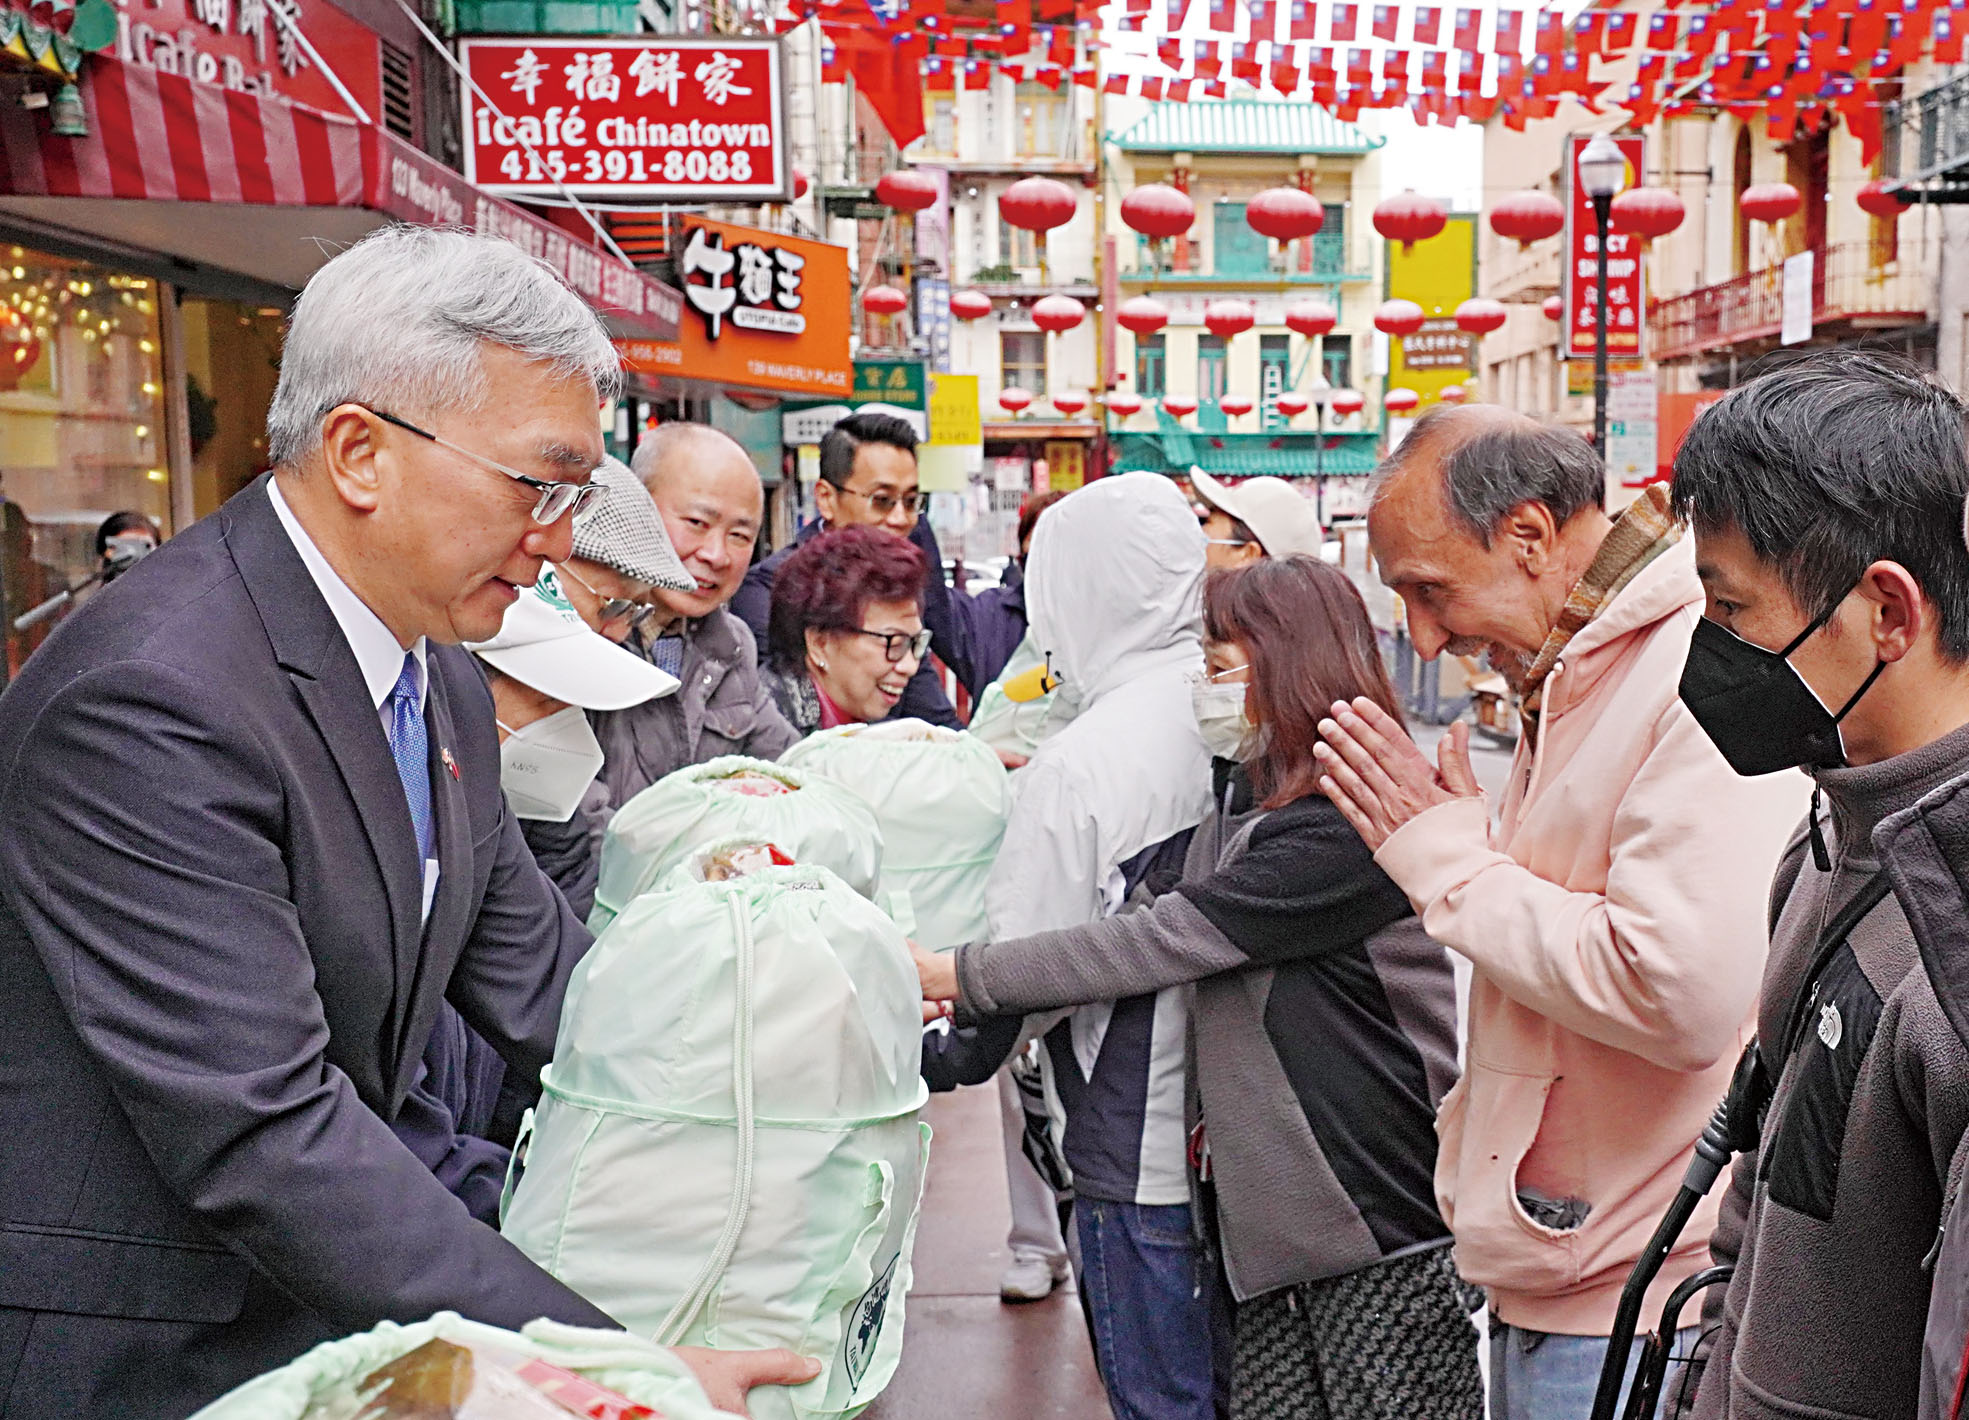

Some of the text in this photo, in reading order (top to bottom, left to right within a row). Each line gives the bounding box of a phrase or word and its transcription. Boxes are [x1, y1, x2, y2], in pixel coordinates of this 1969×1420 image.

[500, 48, 752, 107] 幸福餅家
[476, 105, 770, 147] icafé Chinatown
[500, 150, 752, 182] 415-391-8088
[1584, 234, 1629, 253] SCY
[1578, 259, 1636, 278] SHIMP
